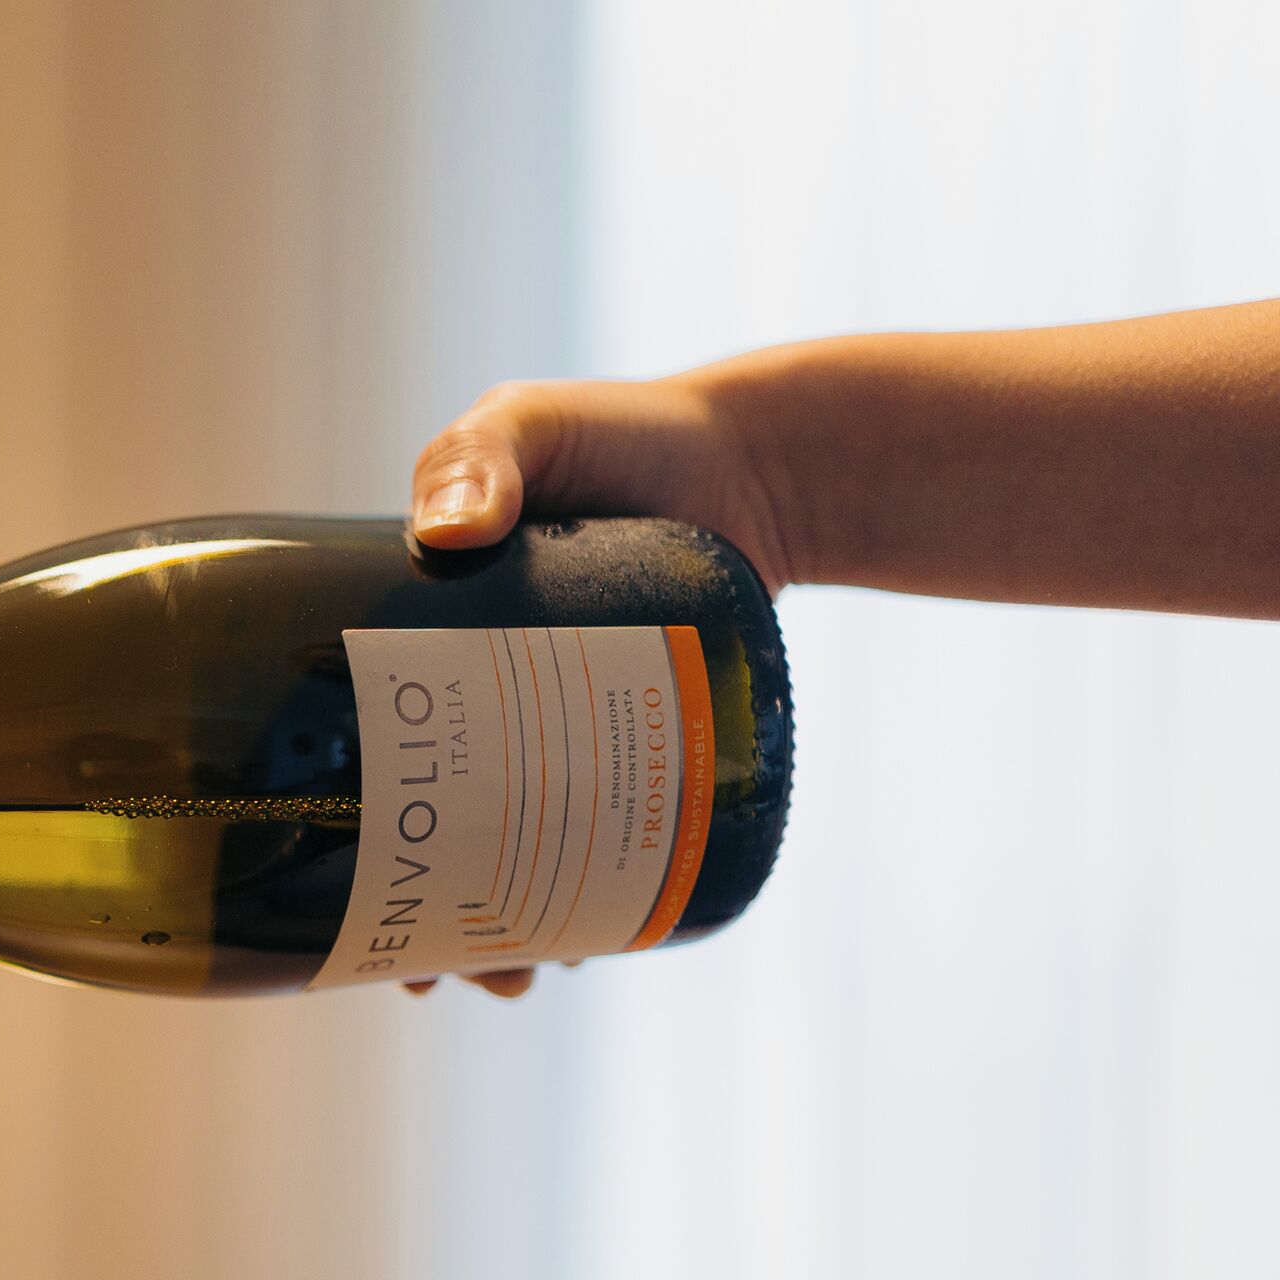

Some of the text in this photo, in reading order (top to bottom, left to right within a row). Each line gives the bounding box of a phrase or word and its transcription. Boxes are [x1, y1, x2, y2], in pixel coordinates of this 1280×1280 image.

[448, 679, 469, 776] ITALIA
[607, 689, 620, 809] DENOMINAZIONE
[616, 688, 637, 871] DI ORIGINE CONTROLLATA
[640, 687, 667, 850] PROSECCO
[688, 719, 704, 841] SUSTAINABLE
